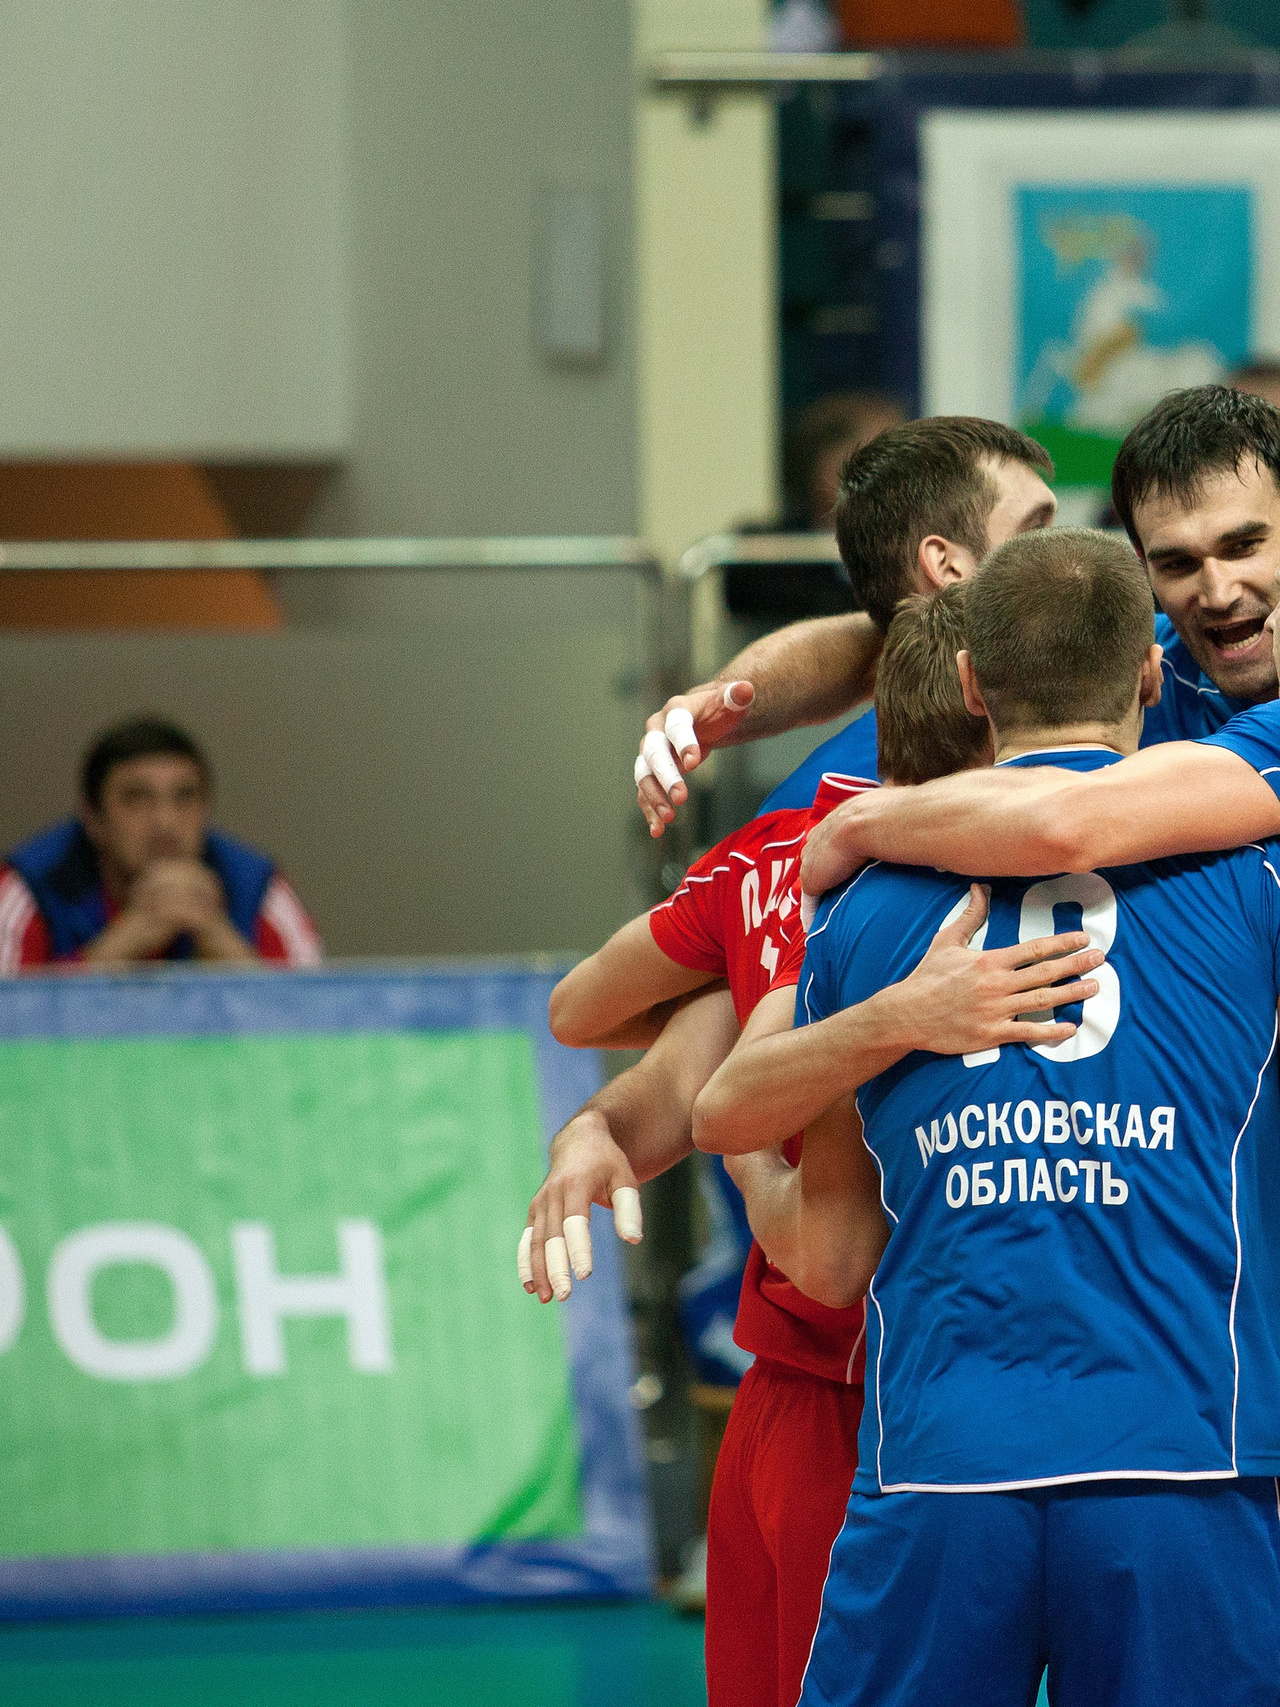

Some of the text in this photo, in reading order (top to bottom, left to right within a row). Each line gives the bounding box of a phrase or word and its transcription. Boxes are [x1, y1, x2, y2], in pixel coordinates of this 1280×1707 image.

[915, 1100, 1177, 1168] МОСКОВСКАЯ
[945, 1157, 1129, 1208] ОБЛАСТЬ
[0, 1217, 396, 1384] ОН
